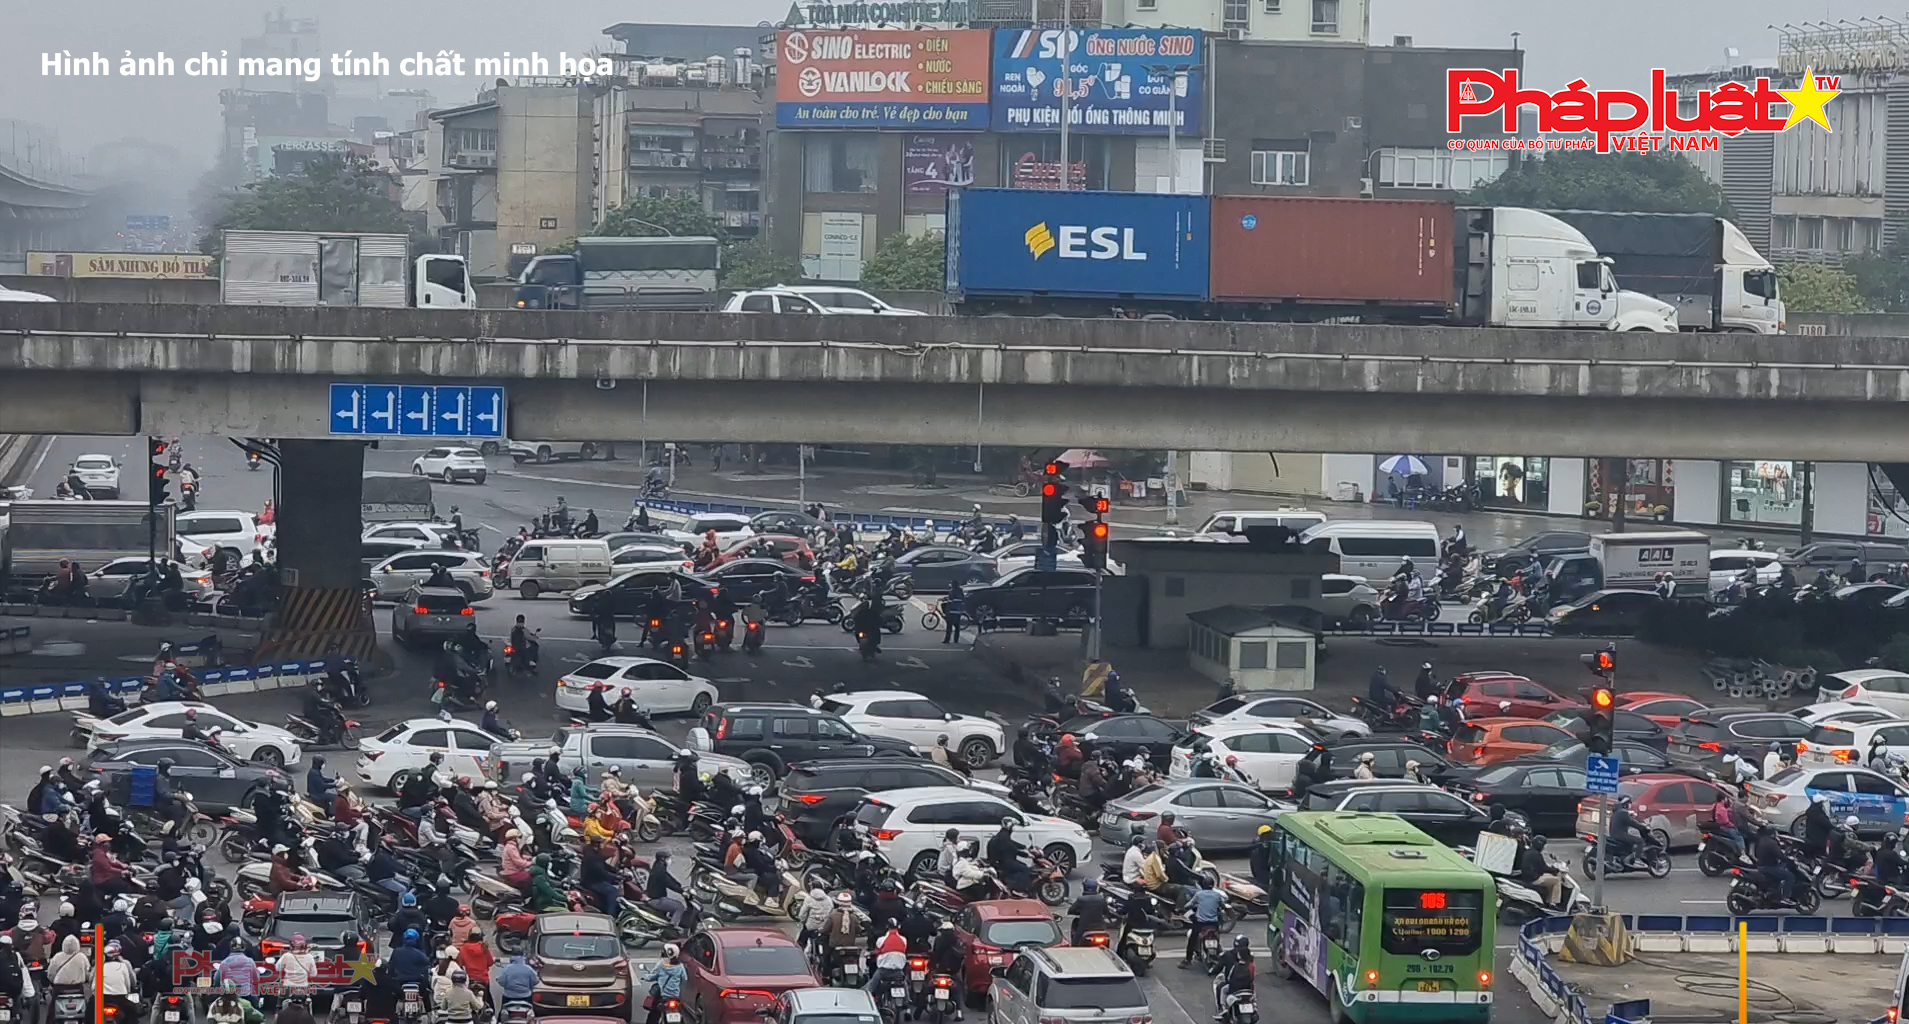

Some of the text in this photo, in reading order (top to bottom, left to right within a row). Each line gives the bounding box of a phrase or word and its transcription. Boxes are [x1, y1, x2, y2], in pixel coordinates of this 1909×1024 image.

[811, 36, 911, 60] SINO ELECTRIC
[1087, 35, 1194, 57] ỐNG NƯỚC SINO
[823, 71, 912, 93] VANLOCK
[1004, 73, 1021, 82] REN
[795, 106, 809, 119] An
[812, 106, 837, 120] toàn
[844, 106, 861, 120] cho
[899, 106, 921, 124] đẹp
[923, 106, 944, 120] cho
[947, 107, 968, 124] bạn
[1007, 108, 1031, 126] PHỤ
[1032, 105, 1060, 126] KIỆN
[1085, 104, 1109, 125] ỐNG
[1112, 107, 1151, 126] THÔNG
[925, 161, 938, 178] 4
[1059, 225, 1148, 260] ESL
[1640, 550, 1673, 560] AAL
[1420, 892, 1446, 909] 105
